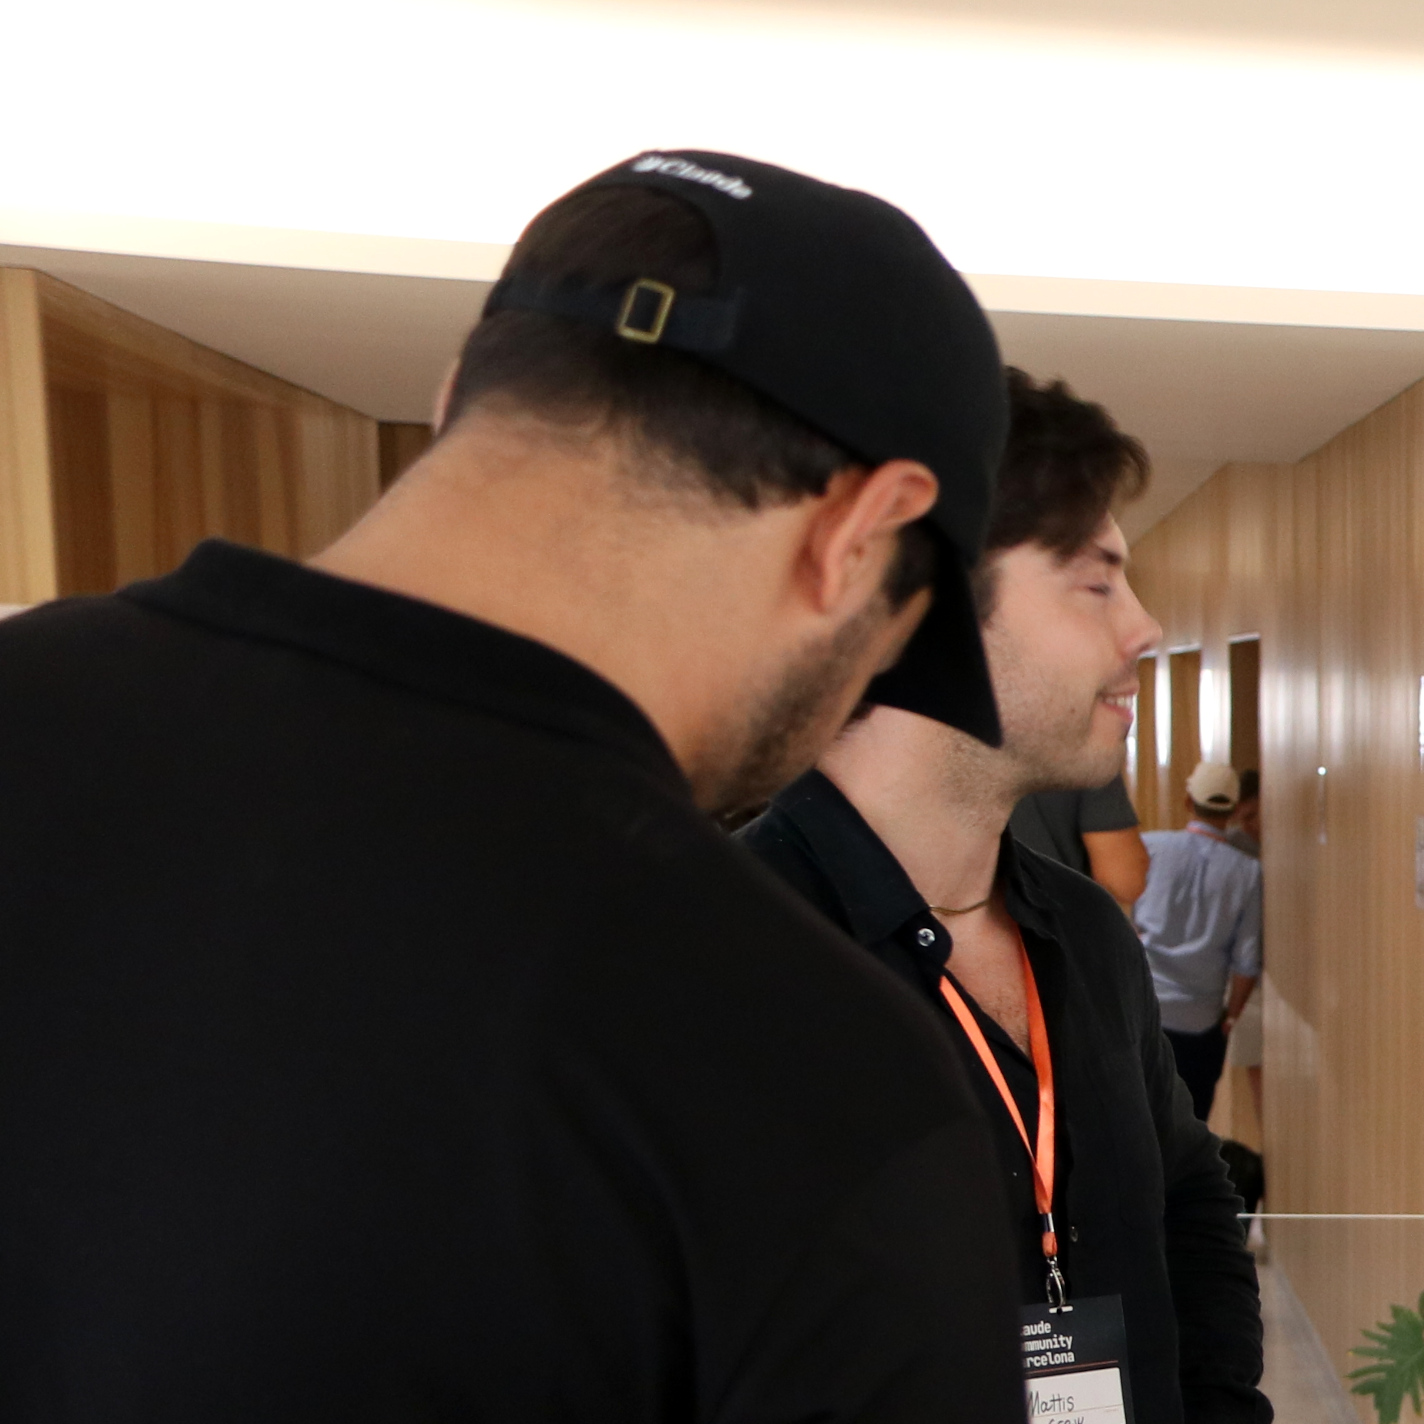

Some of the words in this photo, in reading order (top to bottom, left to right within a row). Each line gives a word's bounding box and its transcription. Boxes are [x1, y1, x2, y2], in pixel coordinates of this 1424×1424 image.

[1022, 1320, 1051, 1336] aude
[1023, 1333, 1073, 1351] mmunity
[1025, 1351, 1075, 1368] rcelona
